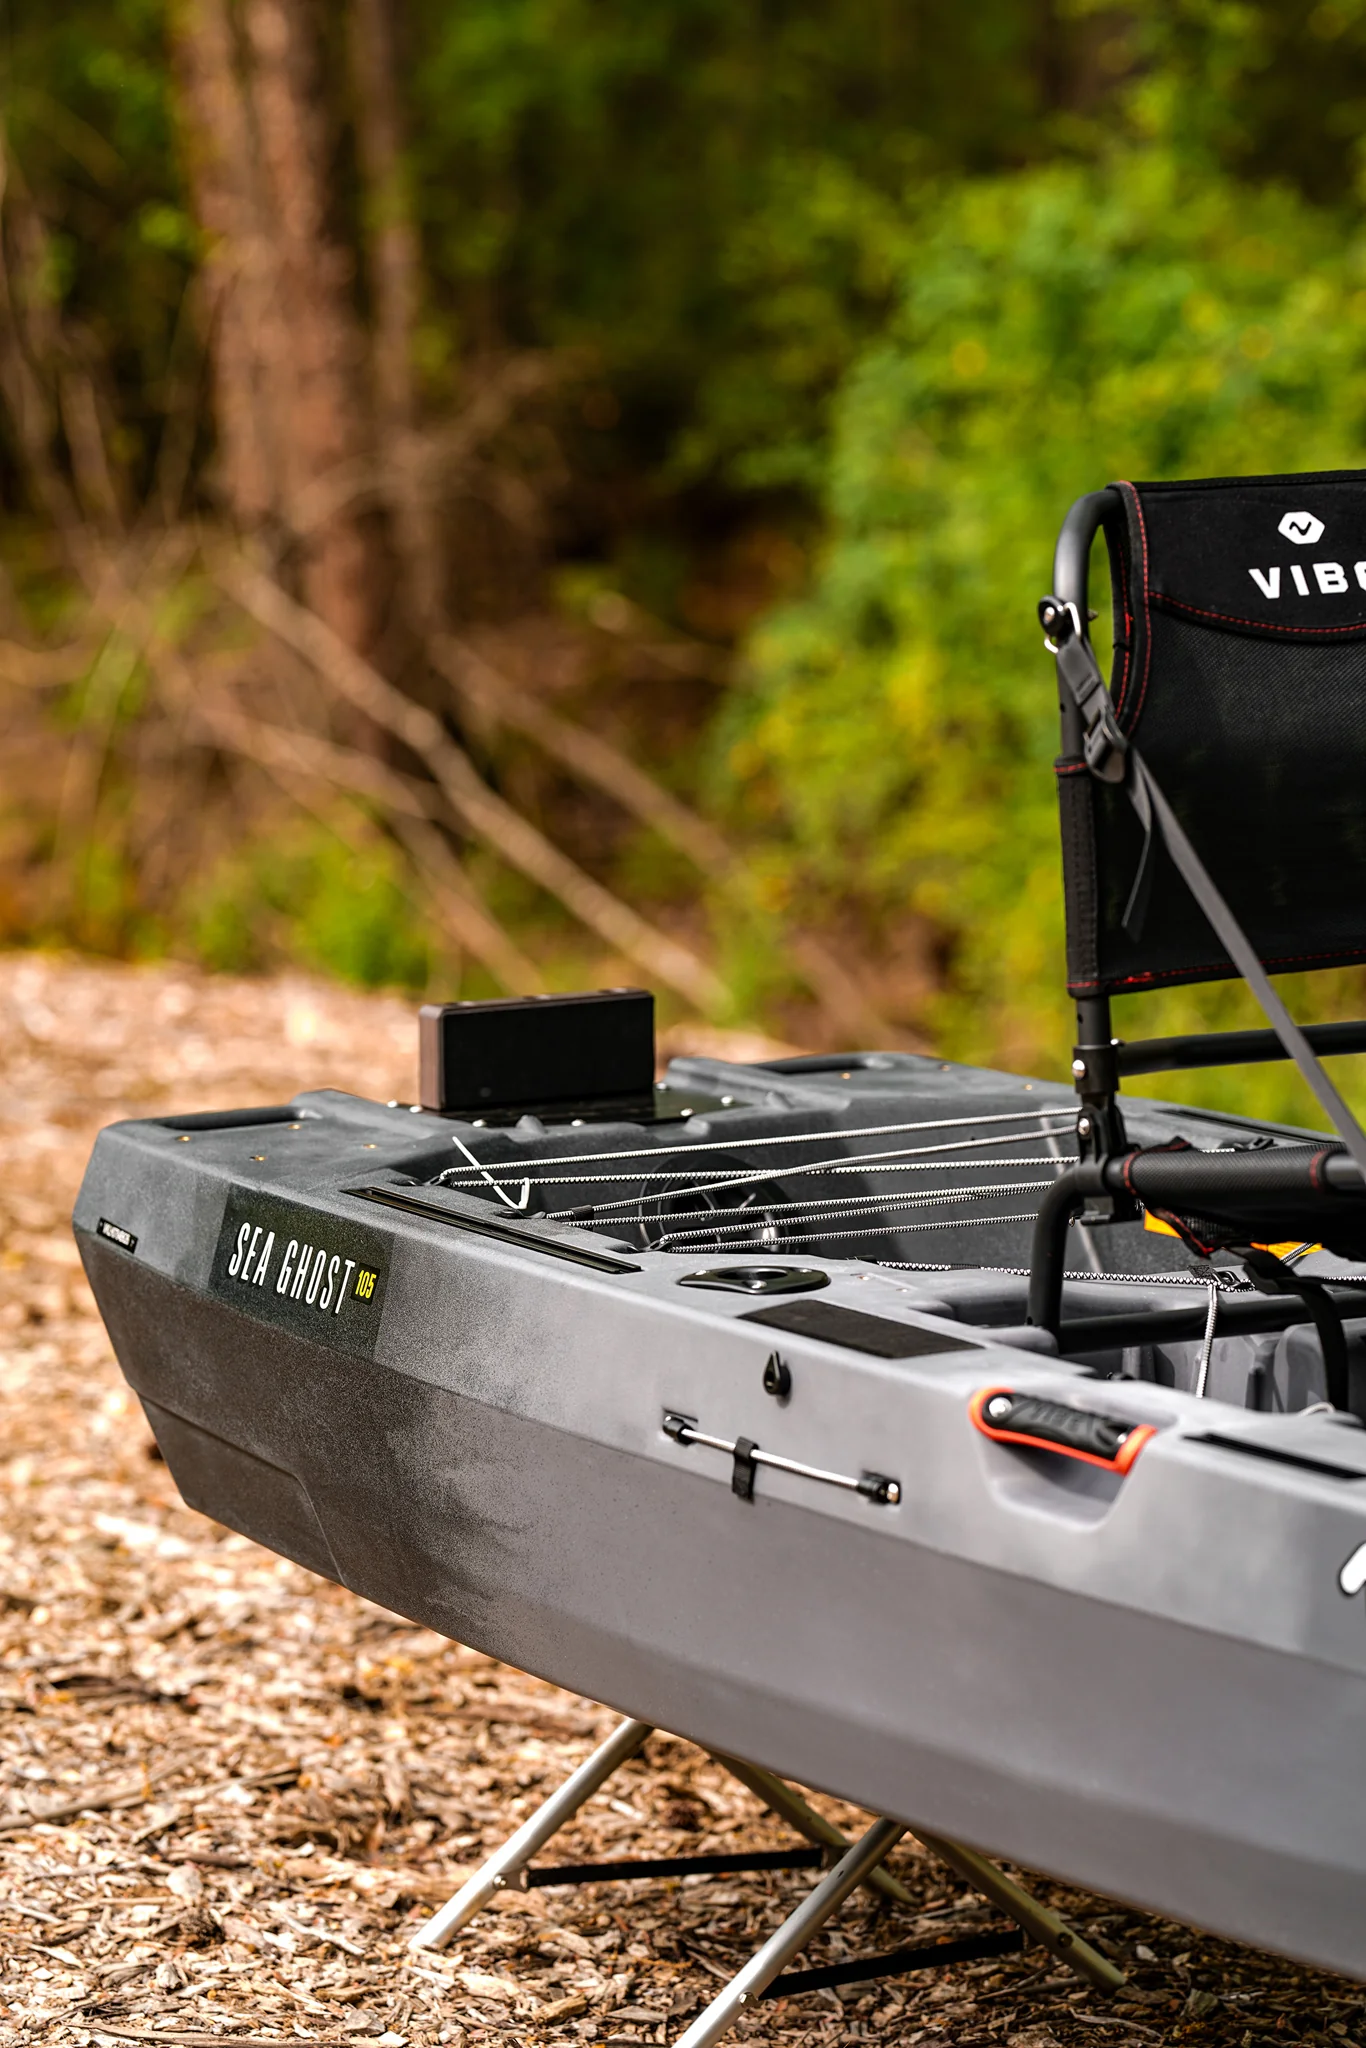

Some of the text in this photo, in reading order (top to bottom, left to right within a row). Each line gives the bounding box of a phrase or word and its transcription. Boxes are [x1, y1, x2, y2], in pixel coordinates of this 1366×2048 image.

[228, 1222, 377, 1314] SEA GHOST 105
